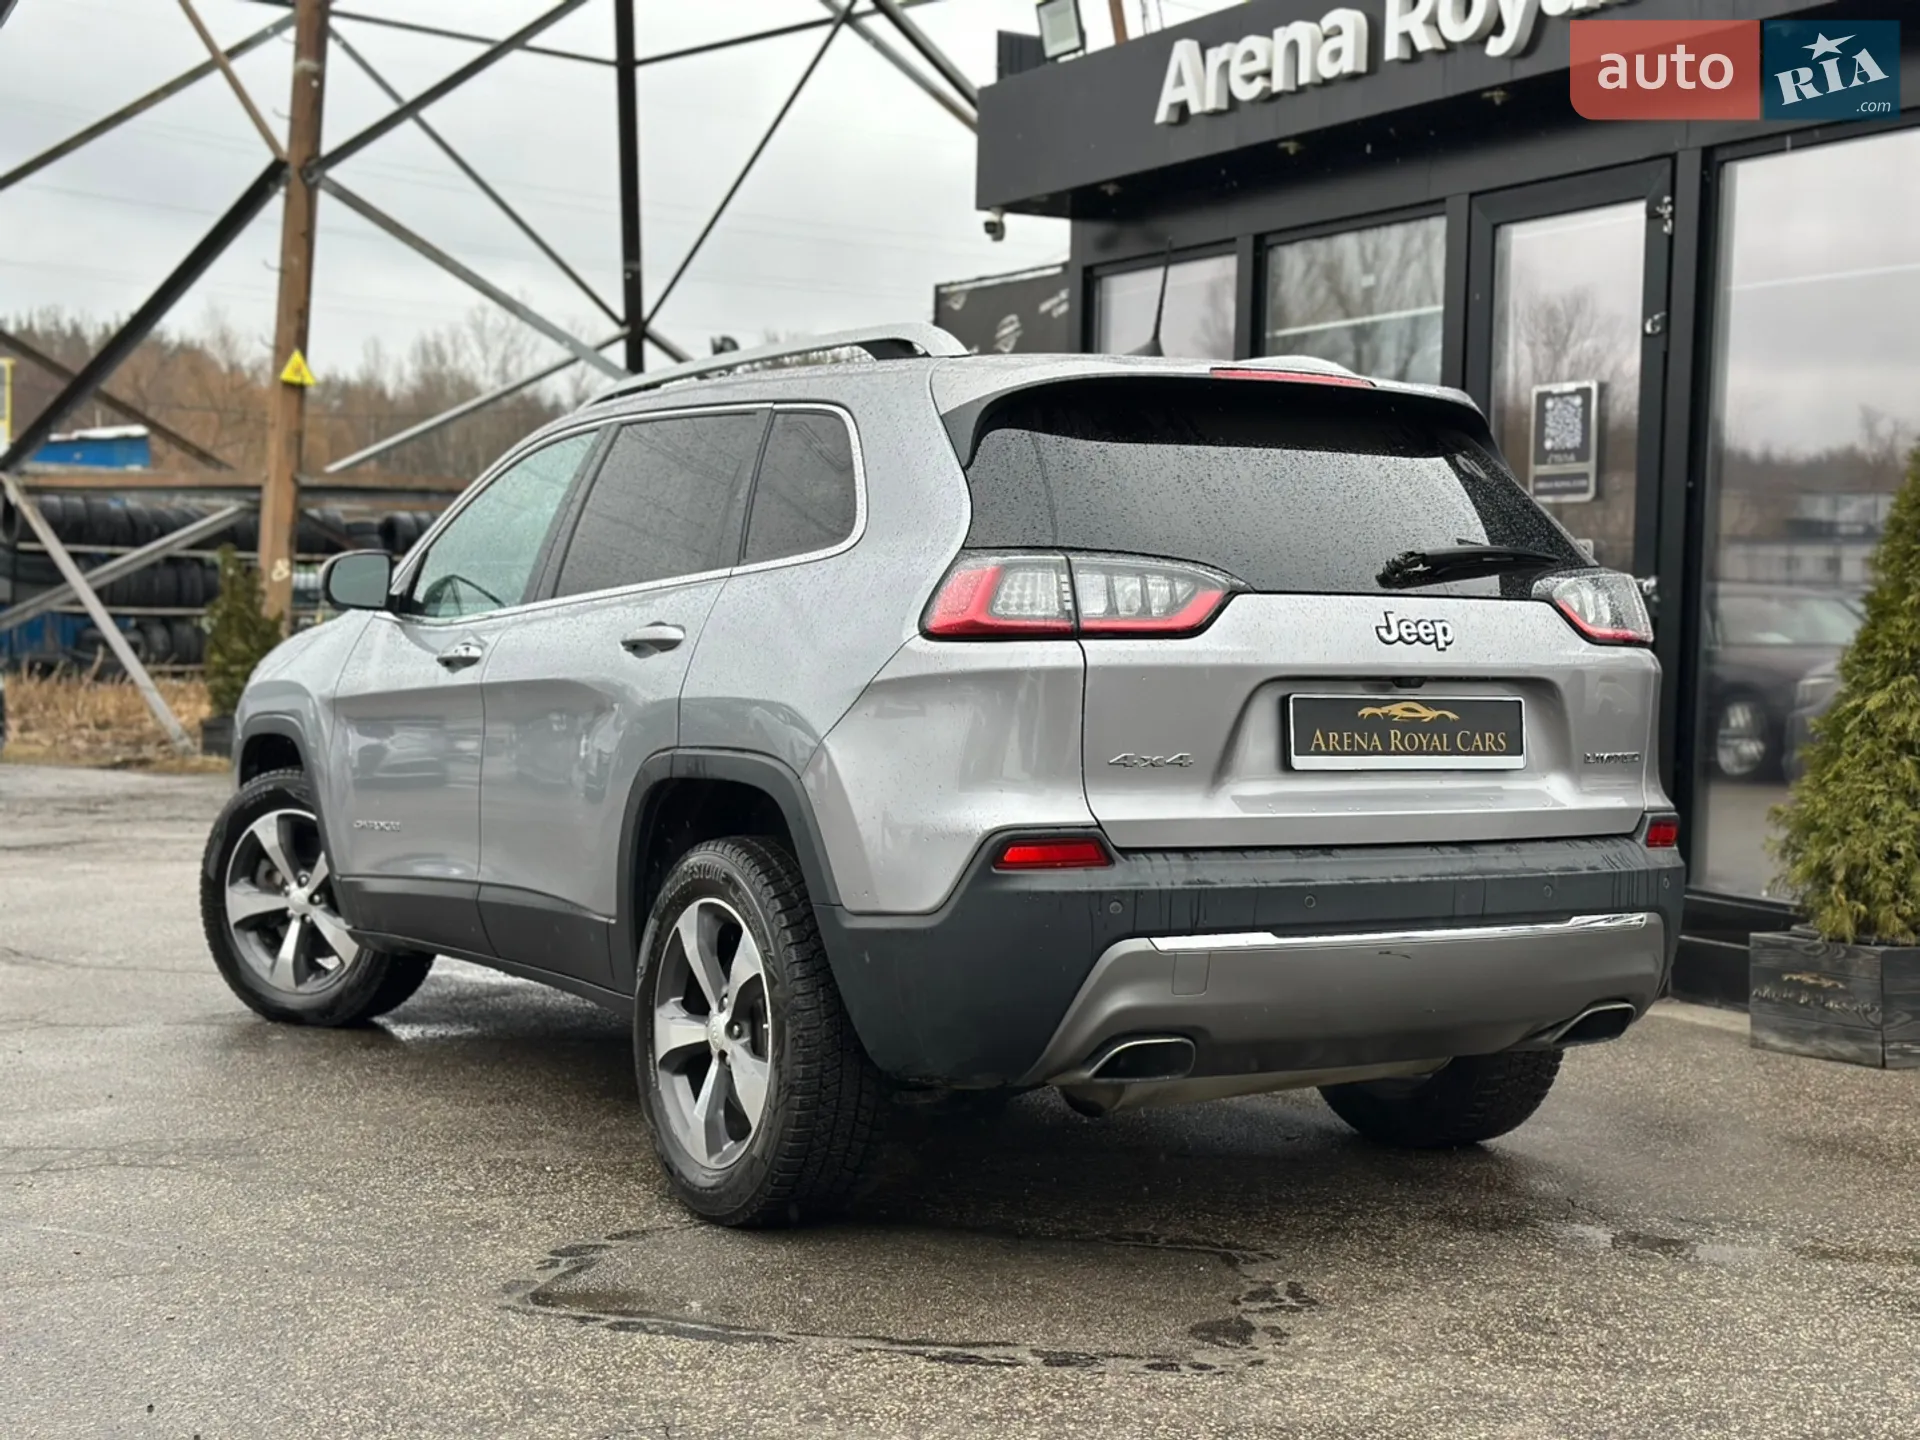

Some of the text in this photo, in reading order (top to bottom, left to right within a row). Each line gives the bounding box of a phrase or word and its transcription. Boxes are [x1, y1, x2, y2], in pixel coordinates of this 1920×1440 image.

[1154, 8, 1368, 124] Arena
[1375, 610, 1455, 652] Jeep
[1309, 728, 1506, 752] ARENA ROYAL CARS
[1107, 752, 1194, 768] 4x4
